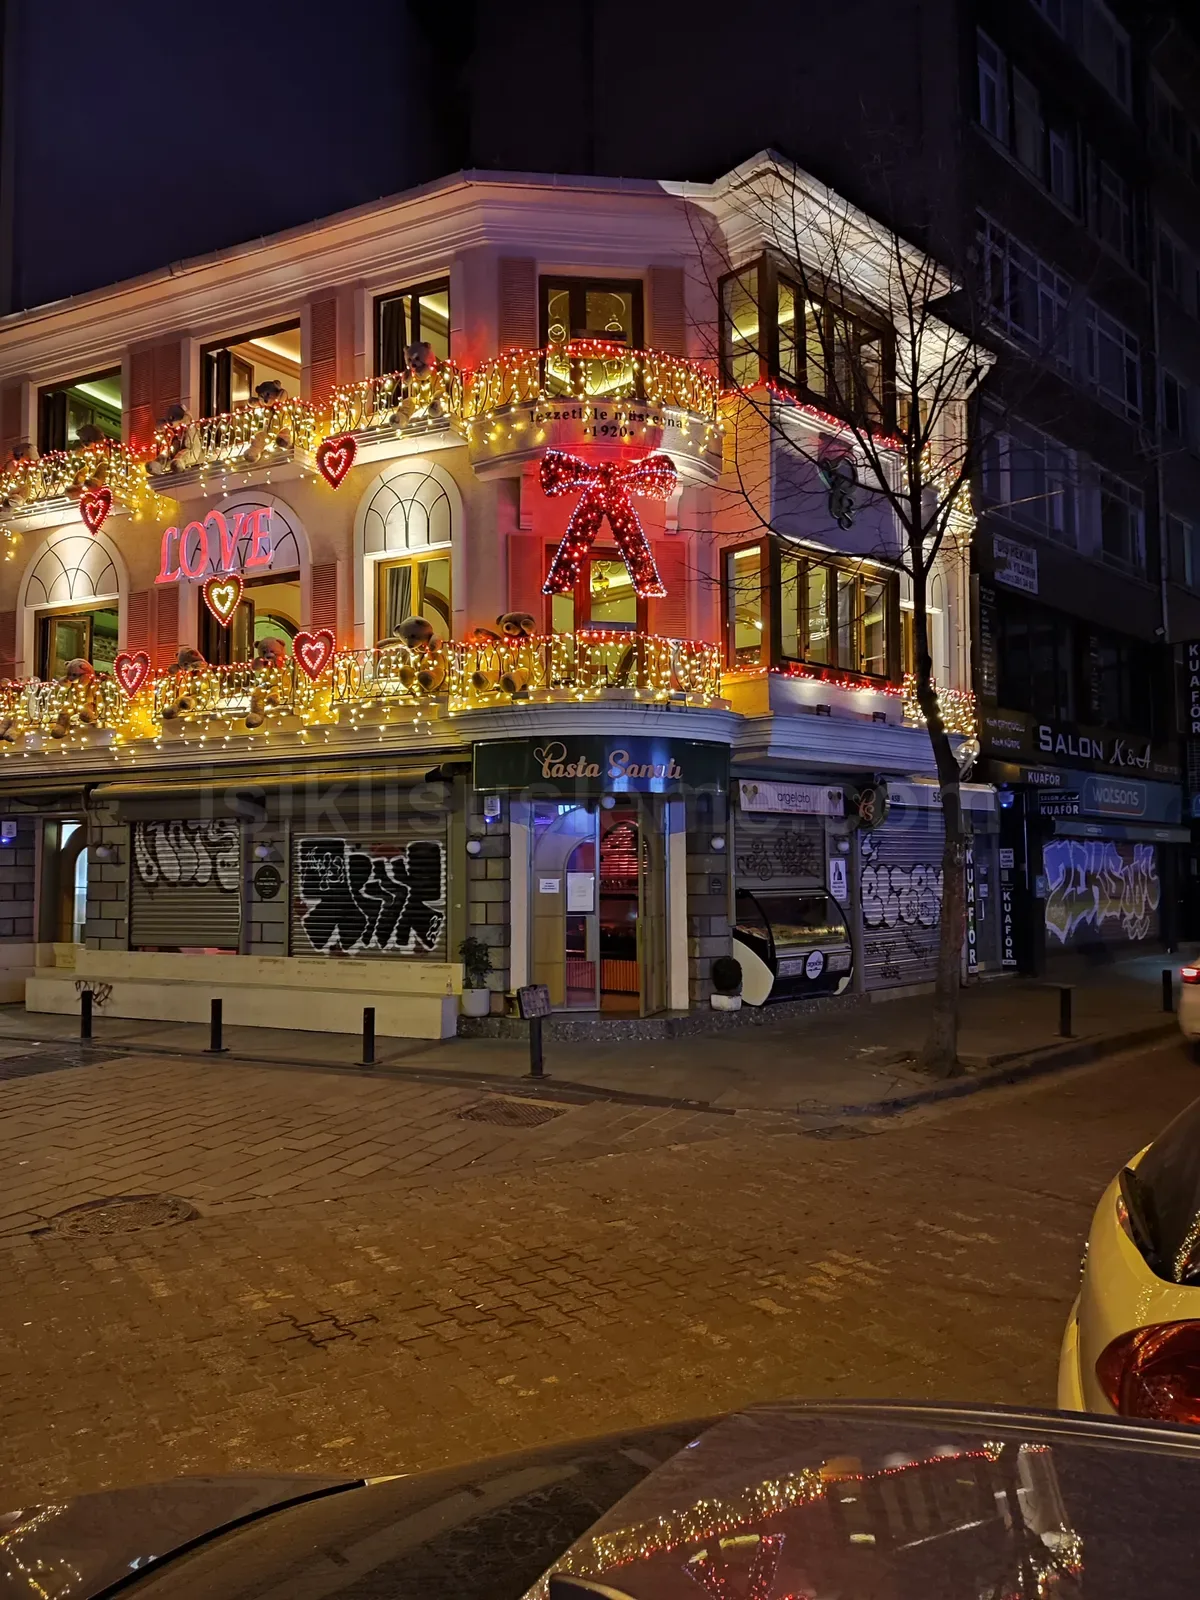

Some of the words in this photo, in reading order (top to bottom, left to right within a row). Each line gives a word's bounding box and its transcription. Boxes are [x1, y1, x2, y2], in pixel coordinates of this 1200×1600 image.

[154, 507, 274, 584] LOVE
[1188, 644, 1200, 734] KUAFÖR
[533, 741, 602, 778] Pasta
[1040, 802, 1079, 815] KUAFÖR
[1092, 785, 1140, 806] watsons
[1002, 891, 1014, 959] KUAFÖR
